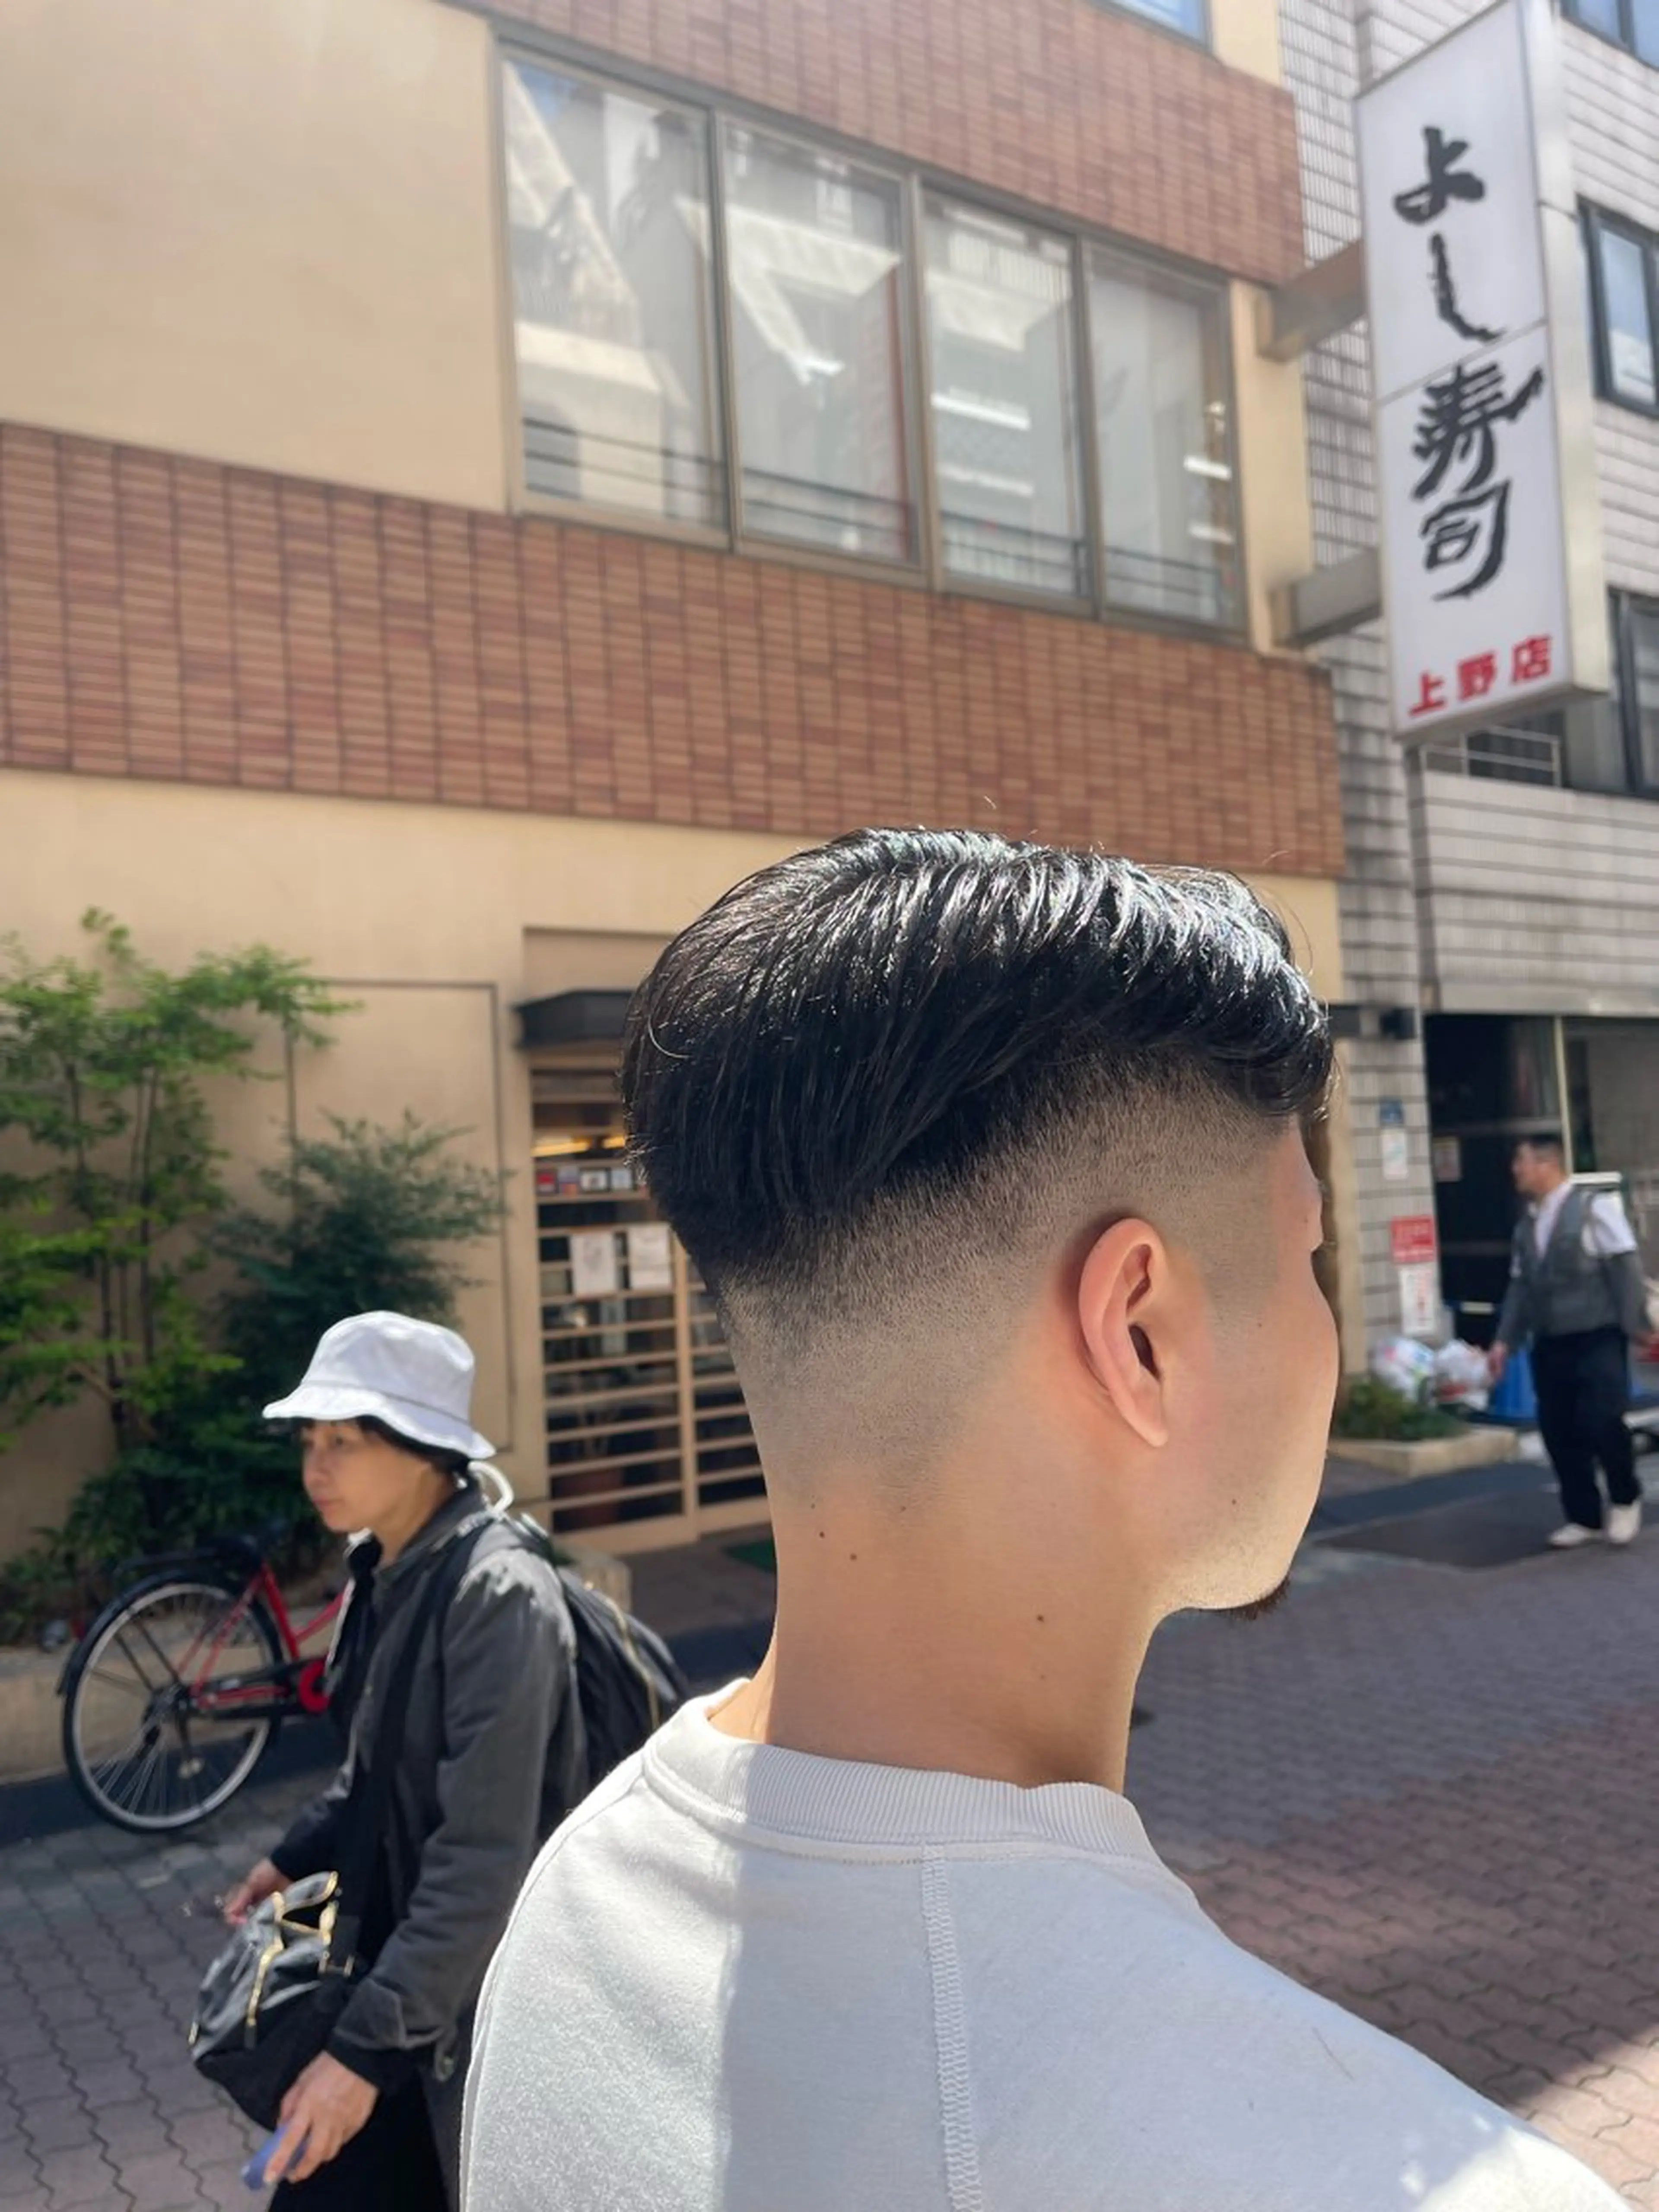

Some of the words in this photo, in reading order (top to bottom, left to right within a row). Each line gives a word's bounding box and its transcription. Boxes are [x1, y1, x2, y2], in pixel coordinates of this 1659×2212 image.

[1394, 126, 1544, 601] よし寿司
[1410, 635, 1551, 714] 上野店
